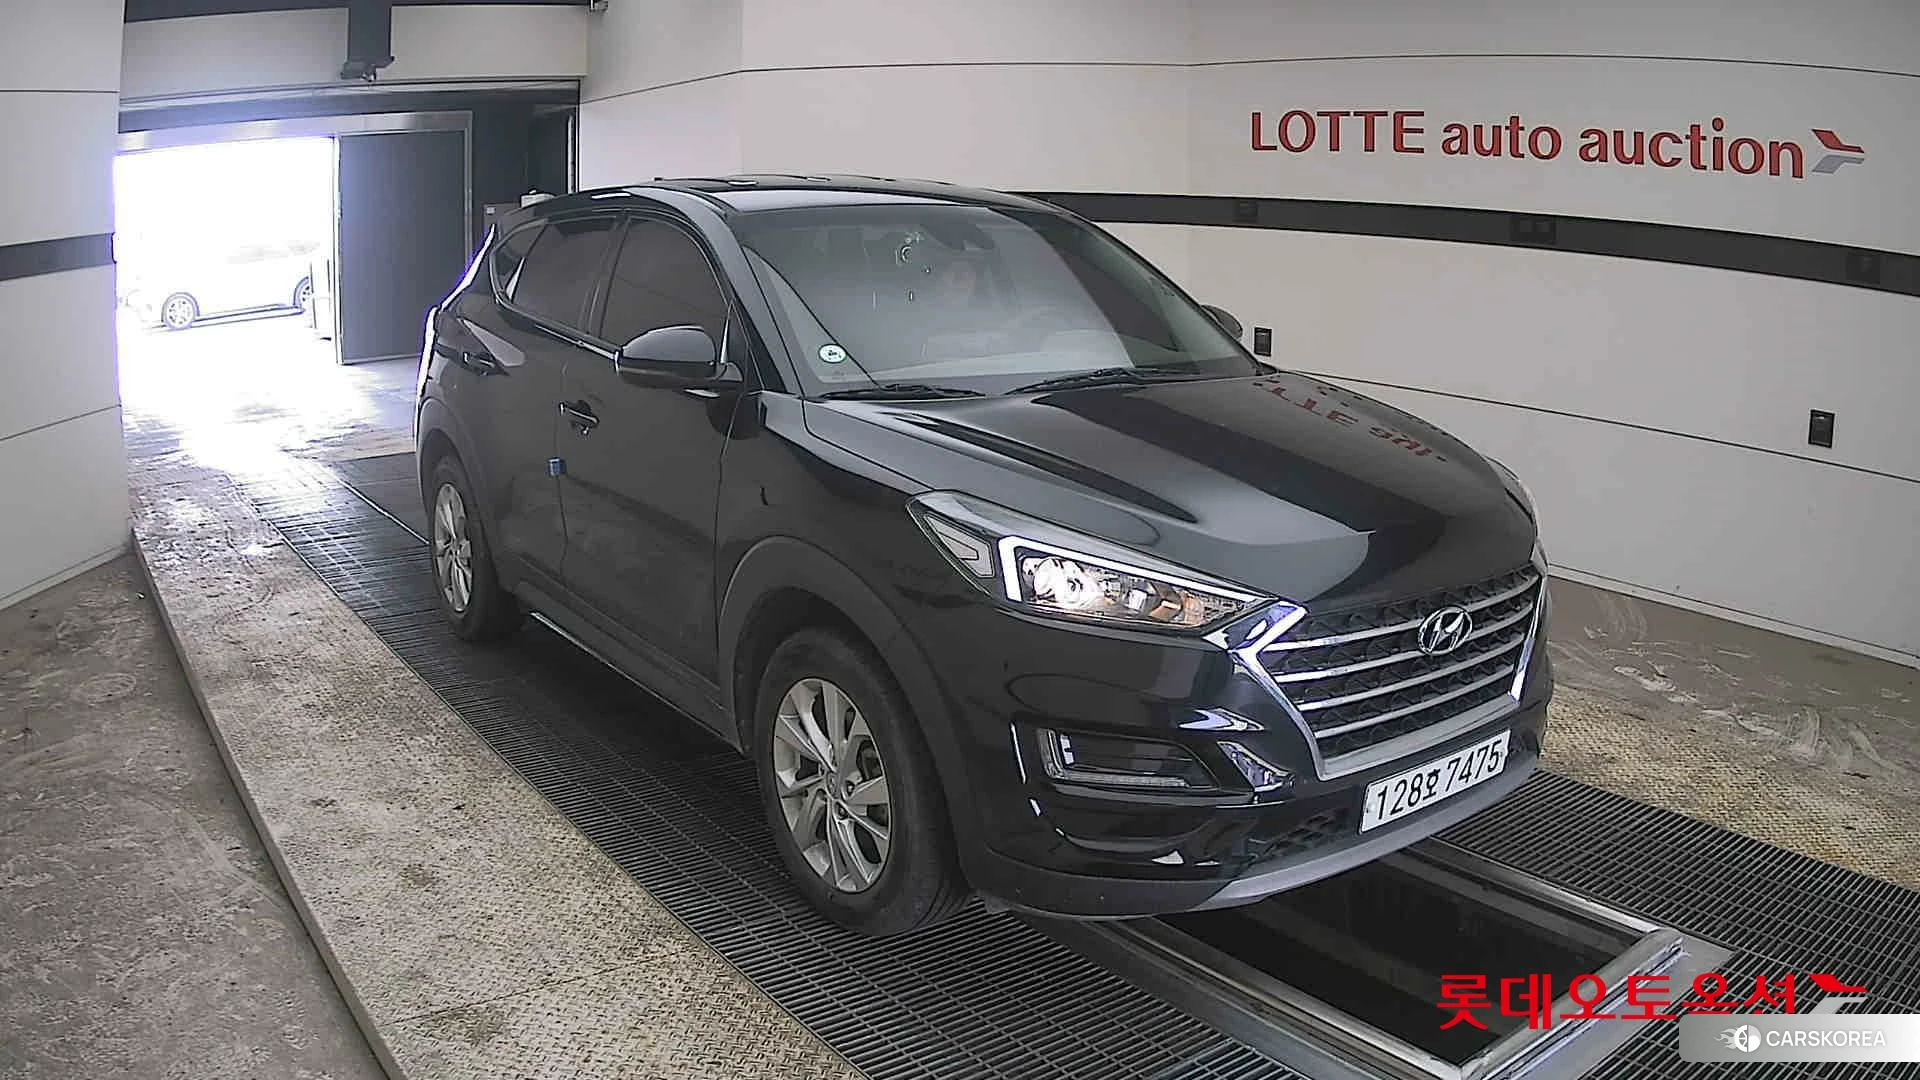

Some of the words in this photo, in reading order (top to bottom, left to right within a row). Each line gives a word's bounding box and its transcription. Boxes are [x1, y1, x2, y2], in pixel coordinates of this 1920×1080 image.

[1252, 111, 1425, 154] LOTTE
[1441, 115, 1562, 160] auto
[1578, 117, 1804, 179] auction
